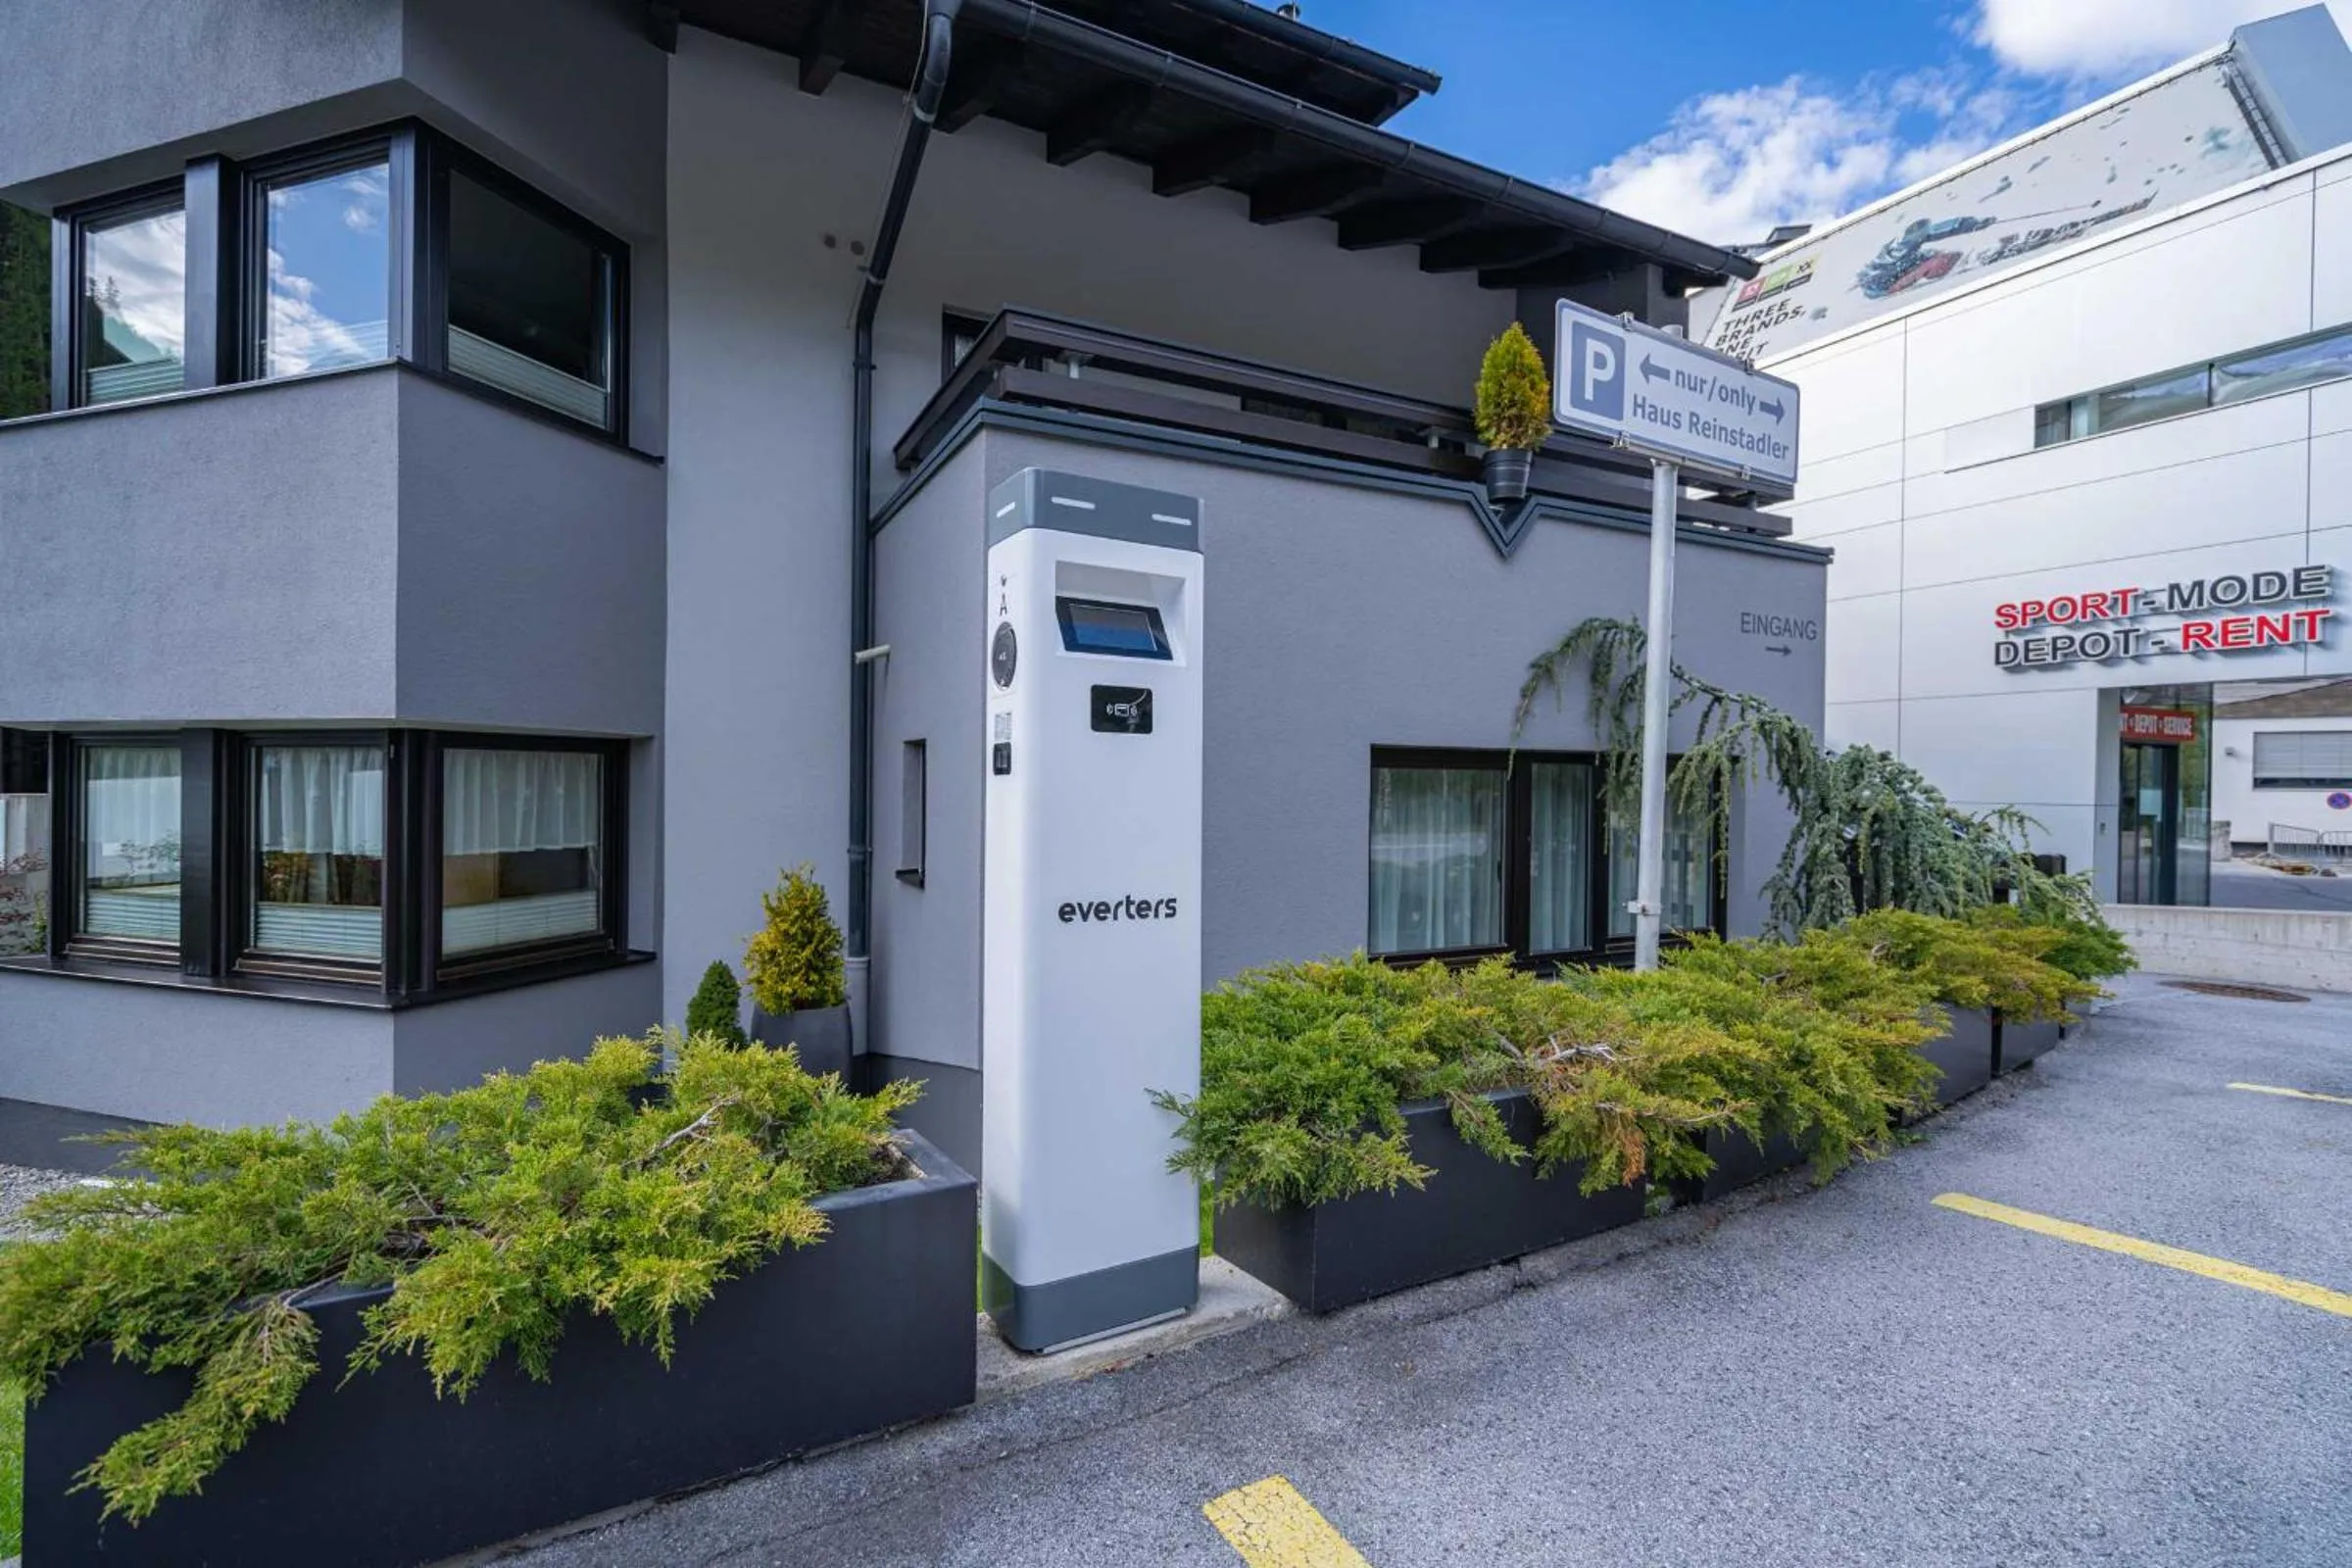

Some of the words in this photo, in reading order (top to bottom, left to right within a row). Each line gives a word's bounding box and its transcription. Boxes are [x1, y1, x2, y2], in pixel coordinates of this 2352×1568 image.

[1585, 338, 1616, 401] P
[1633, 393, 1682, 429] Haus
[1689, 411, 1789, 460] Reinstadler
[1740, 612, 1818, 641] EINGANG
[1057, 894, 1178, 923] everters
